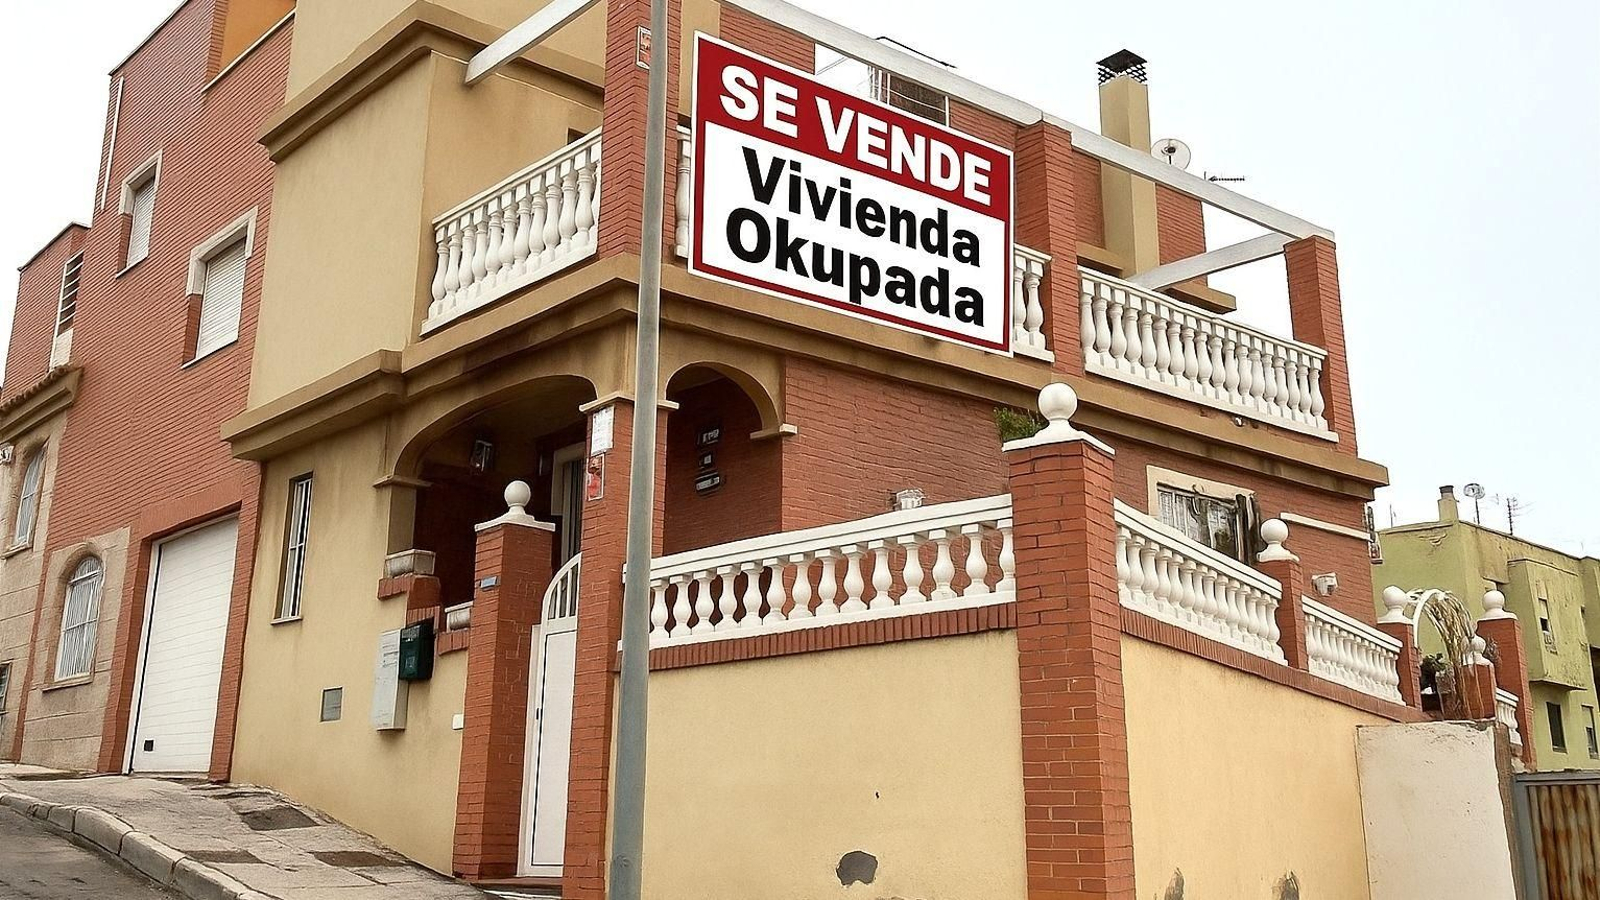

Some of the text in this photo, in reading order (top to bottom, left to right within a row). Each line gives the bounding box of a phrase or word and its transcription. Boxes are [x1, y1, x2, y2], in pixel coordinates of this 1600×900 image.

[718, 65, 992, 207] SE VENDE
[725, 207, 985, 328] Okupada
[741, 145, 981, 268] Vivienda
